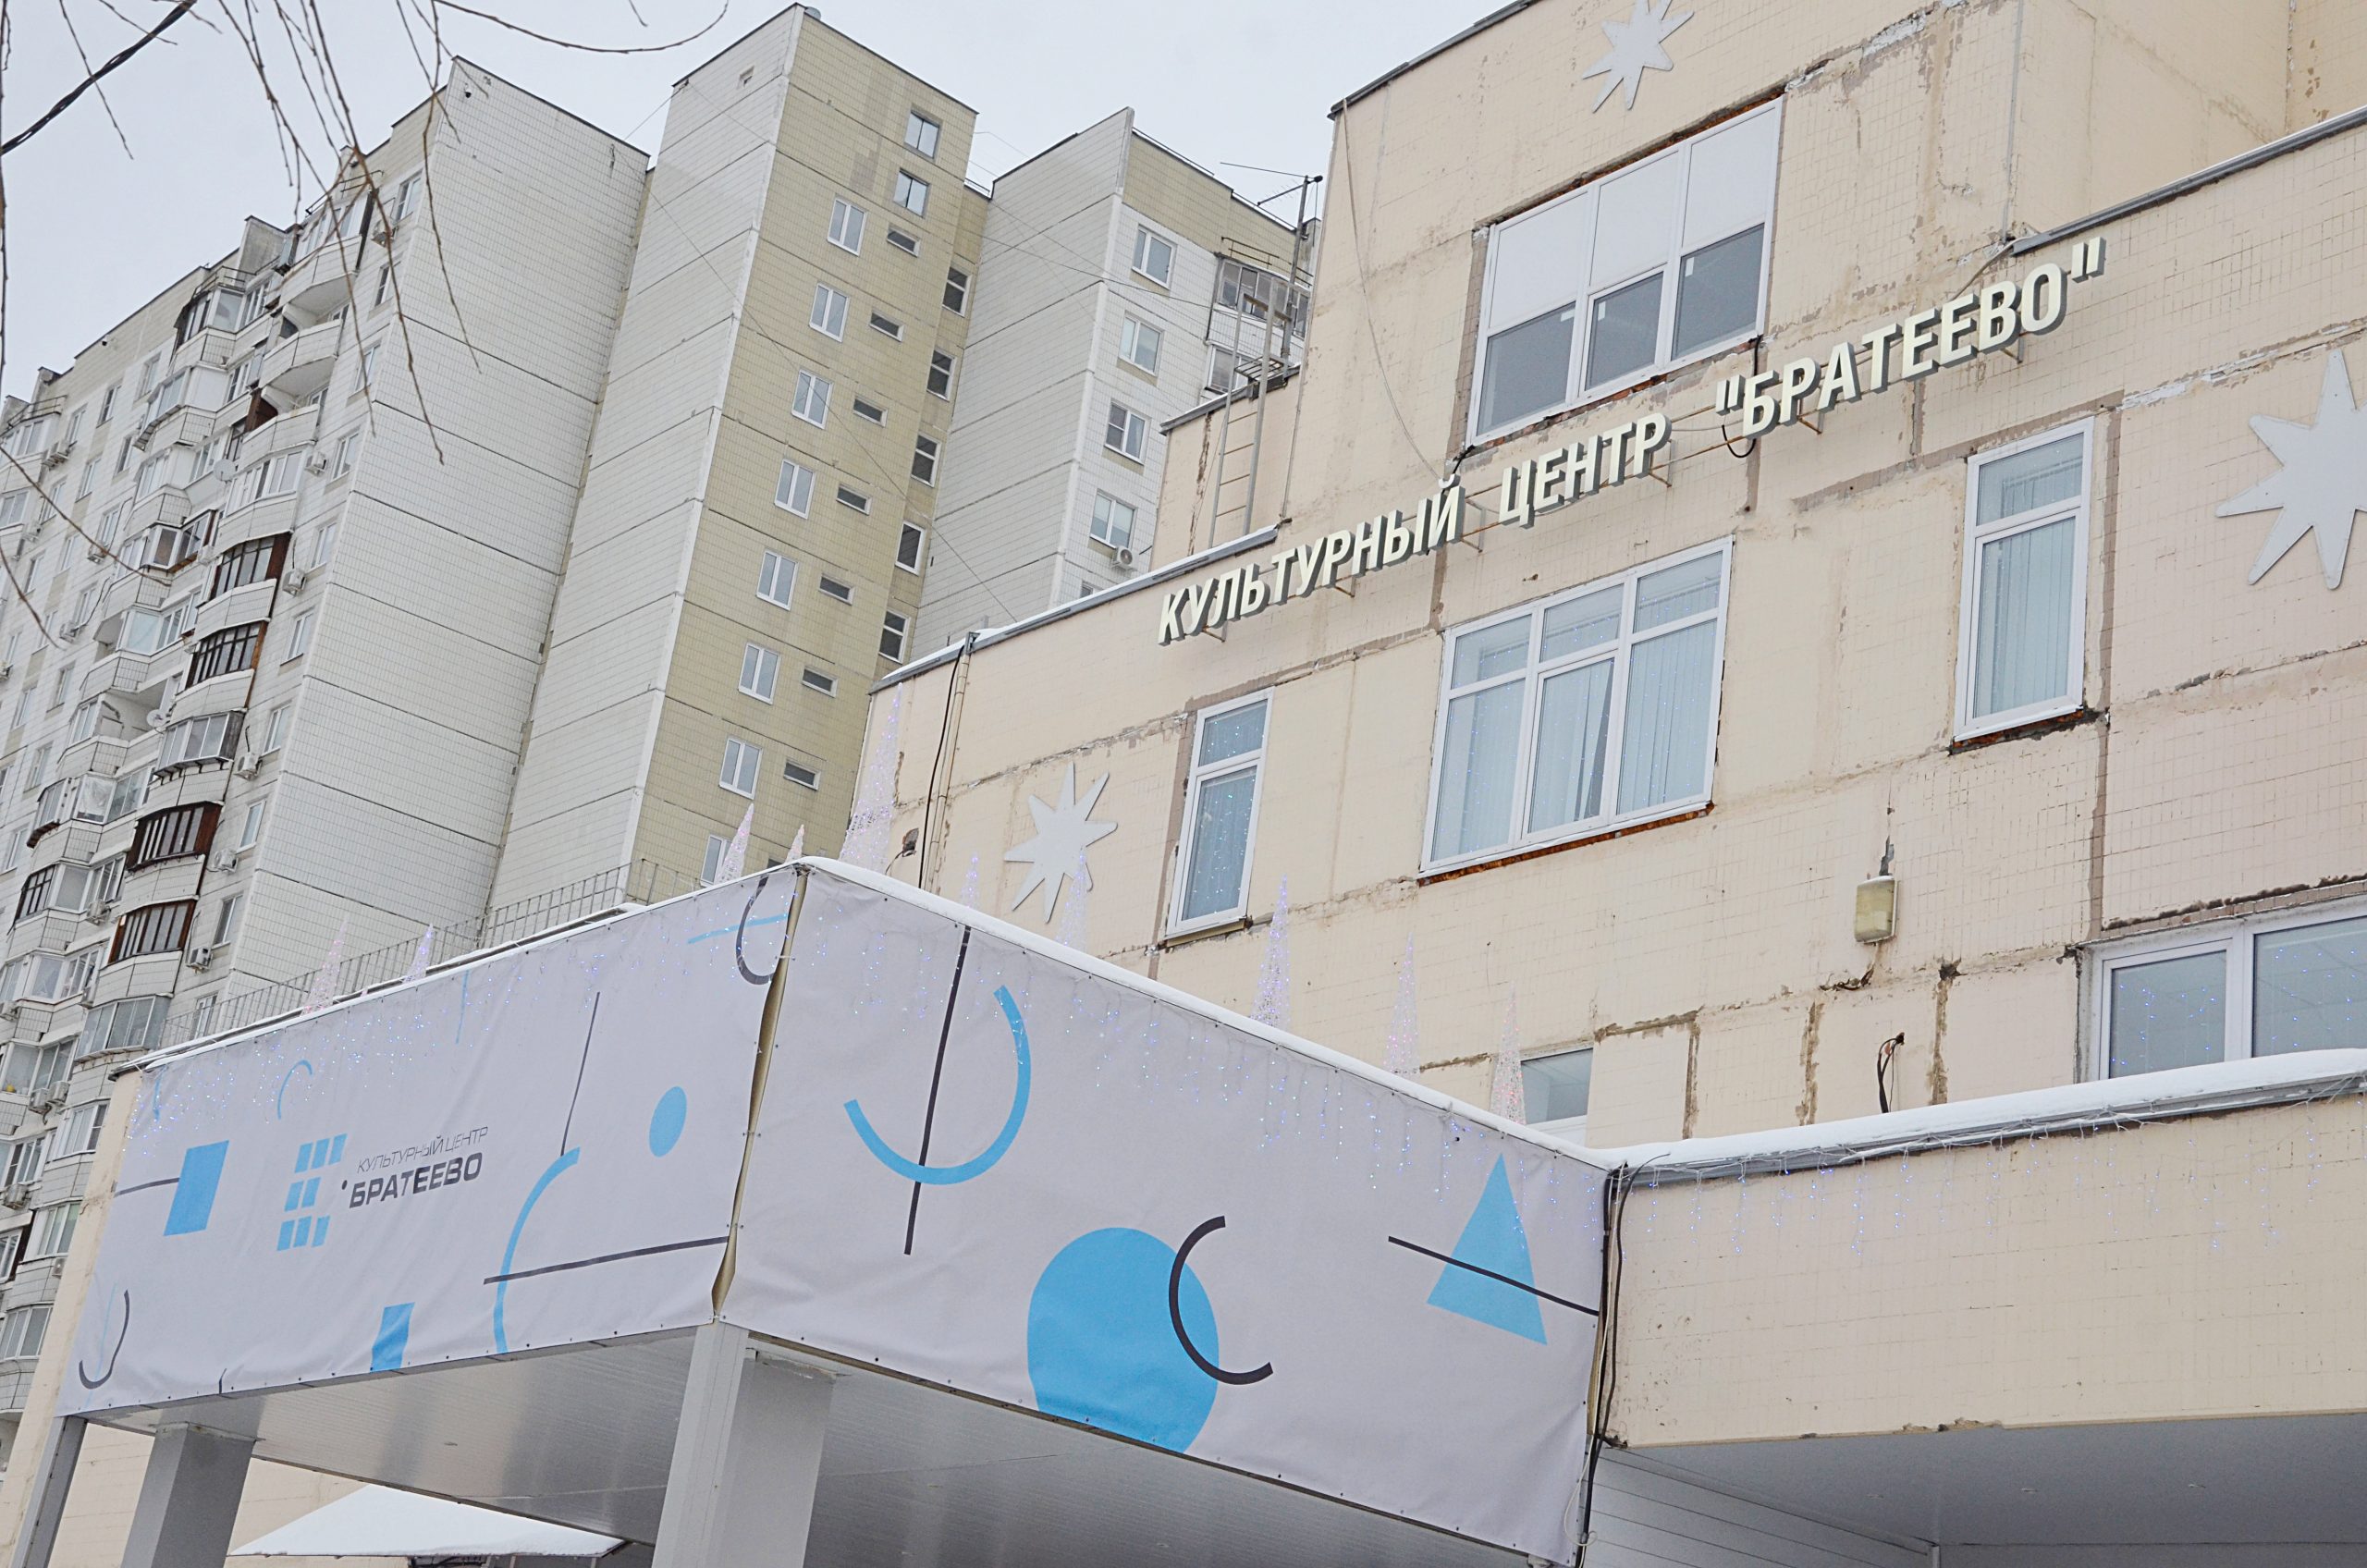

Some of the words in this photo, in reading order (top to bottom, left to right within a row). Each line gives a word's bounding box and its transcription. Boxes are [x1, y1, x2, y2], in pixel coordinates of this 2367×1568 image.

[1158, 473, 1466, 645] КУЛЬТУРНЫЙ
[1499, 413, 1672, 528] ЦЕНТР
[1716, 237, 2105, 438] "БРАТЕЕВО"
[357, 1135, 444, 1173] КУЛЬТУРНЫЙ
[445, 1126, 488, 1152] ЦЕНТР
[350, 1152, 483, 1208] БРАТЕЕВО
